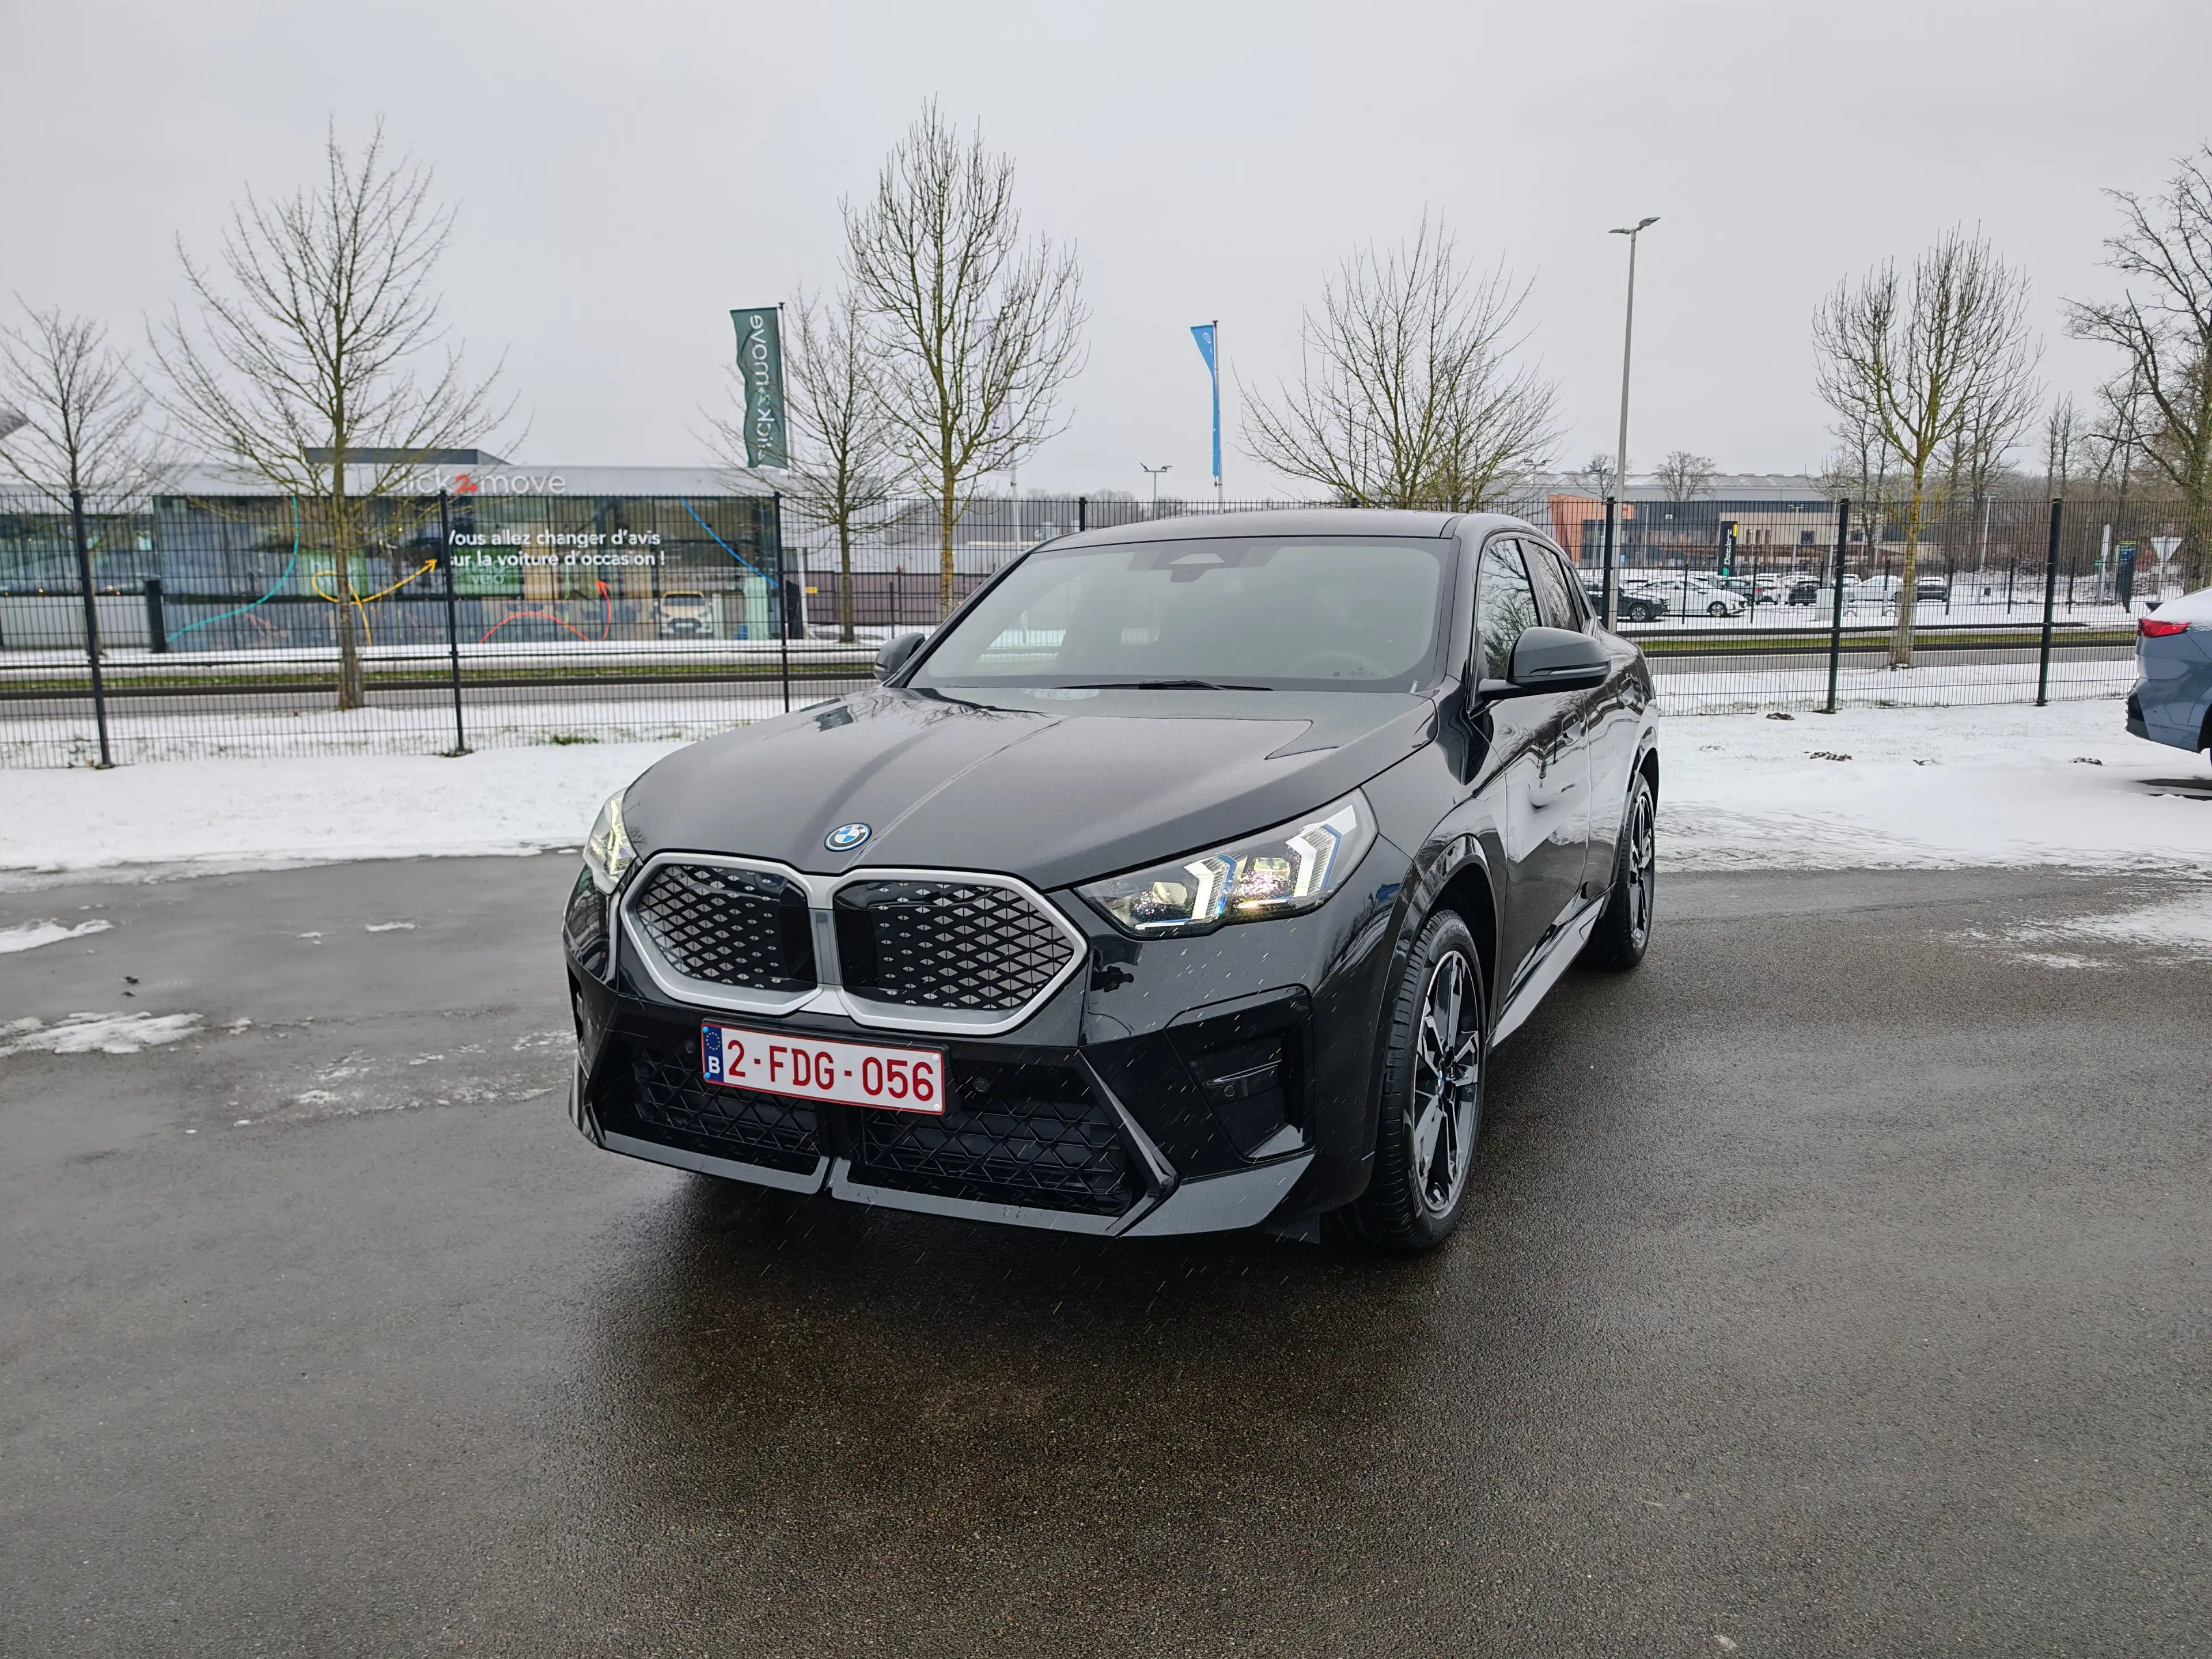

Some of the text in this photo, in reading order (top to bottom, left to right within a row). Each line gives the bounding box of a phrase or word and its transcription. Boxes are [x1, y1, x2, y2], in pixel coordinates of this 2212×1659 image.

[382, 467, 566, 494] lick2move
[491, 528, 531, 546] allez
[536, 528, 606, 548] changer
[477, 549, 492, 566] la
[497, 550, 559, 566] voiture
[660, 550, 665, 566] !
[708, 1056, 721, 1074] B
[728, 1039, 934, 1102] 2-FDG-056
